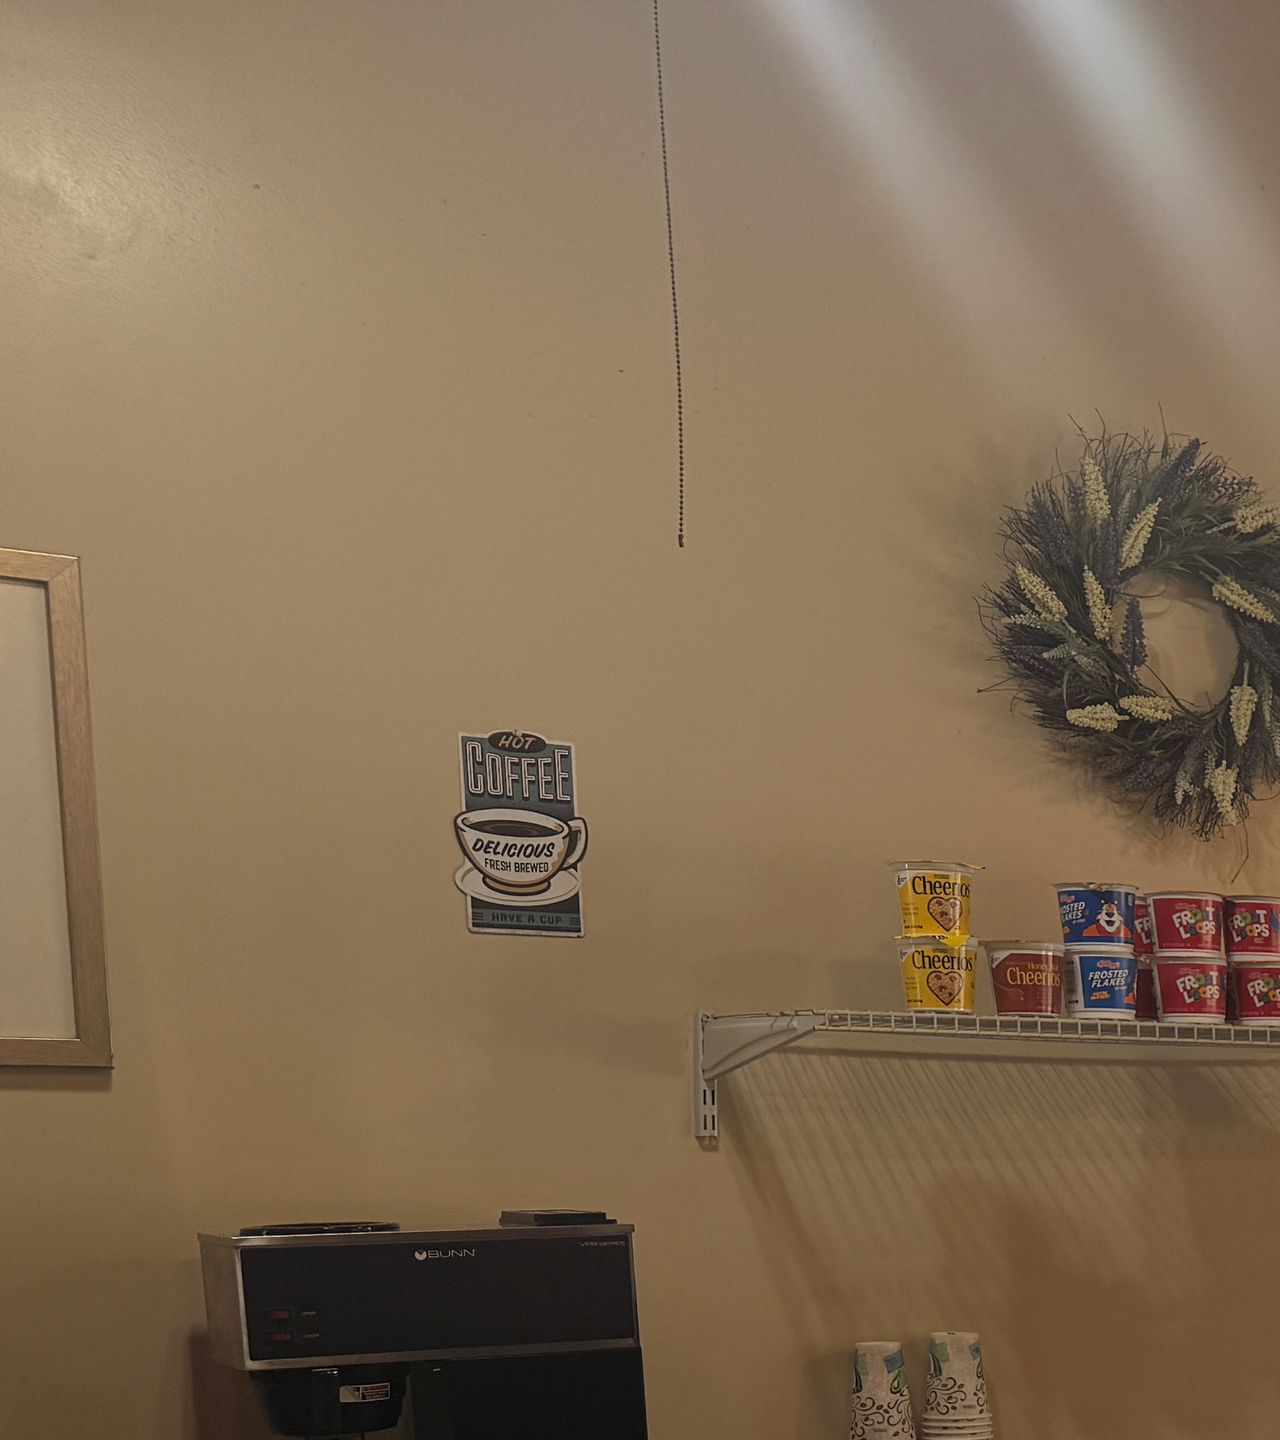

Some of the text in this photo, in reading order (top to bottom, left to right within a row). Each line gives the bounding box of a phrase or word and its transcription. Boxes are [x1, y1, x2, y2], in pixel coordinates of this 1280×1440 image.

[498, 735, 536, 750] HOT
[466, 741, 571, 801] COFFEE
[472, 838, 555, 858] DELICIOUS
[484, 858, 549, 873] FRESH BREWED
[492, 911, 562, 925] HAVE A CUP
[912, 950, 973, 971] Cheerios
[1007, 967, 1060, 986] Cheerios
[1088, 969, 1129, 980] FROSTED
[1091, 977, 1126, 988] FLAKES
[428, 1248, 476, 1260] BUNN
